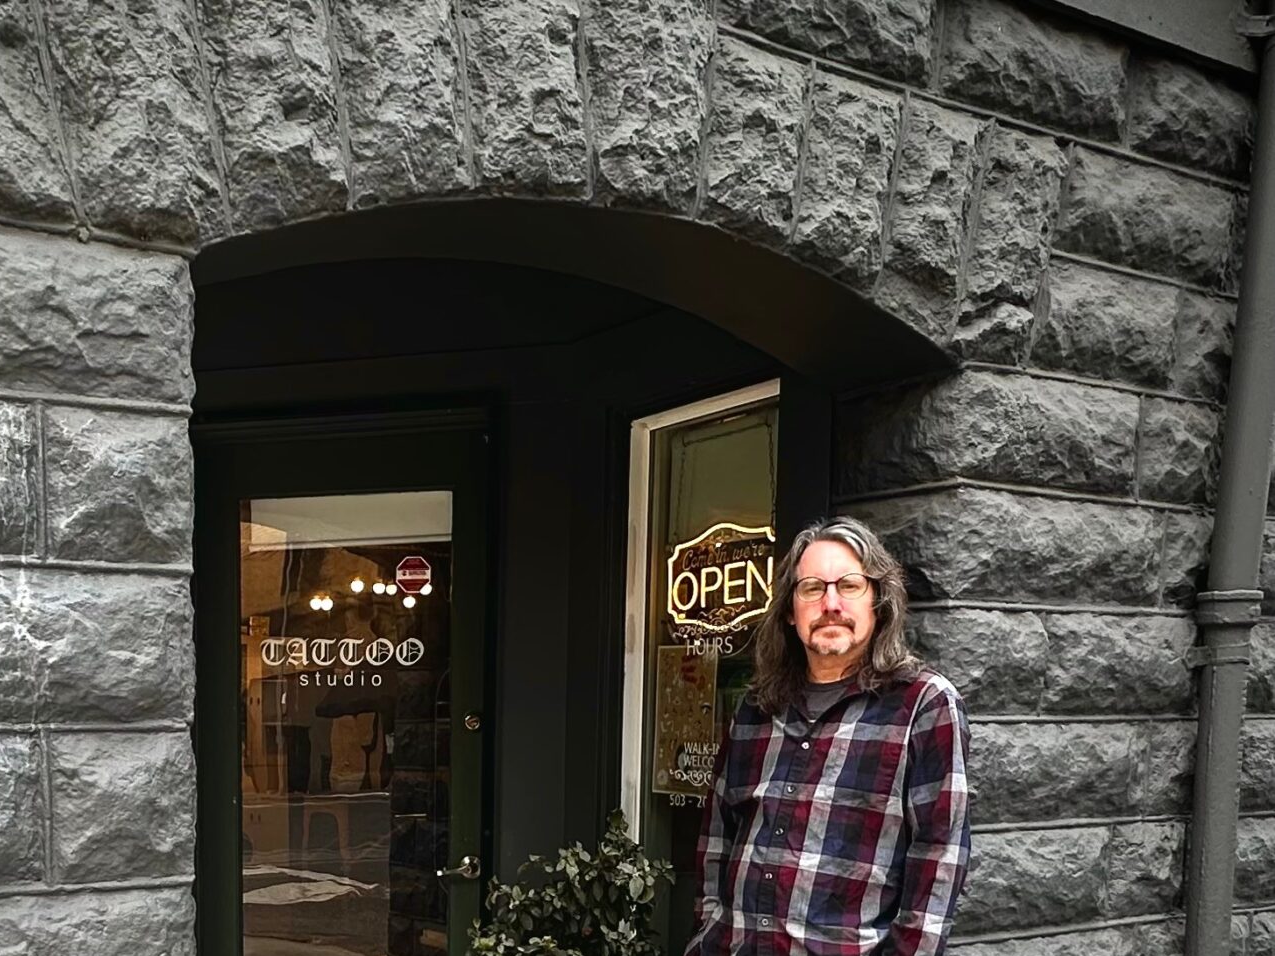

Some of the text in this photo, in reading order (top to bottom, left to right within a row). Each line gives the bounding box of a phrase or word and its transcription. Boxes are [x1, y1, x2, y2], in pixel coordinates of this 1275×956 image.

[672, 556, 774, 611] OPEN
[260, 637, 425, 667] TATTOO
[685, 635, 734, 657] HOURS
[299, 670, 383, 687] studio
[669, 794, 686, 806] 503
